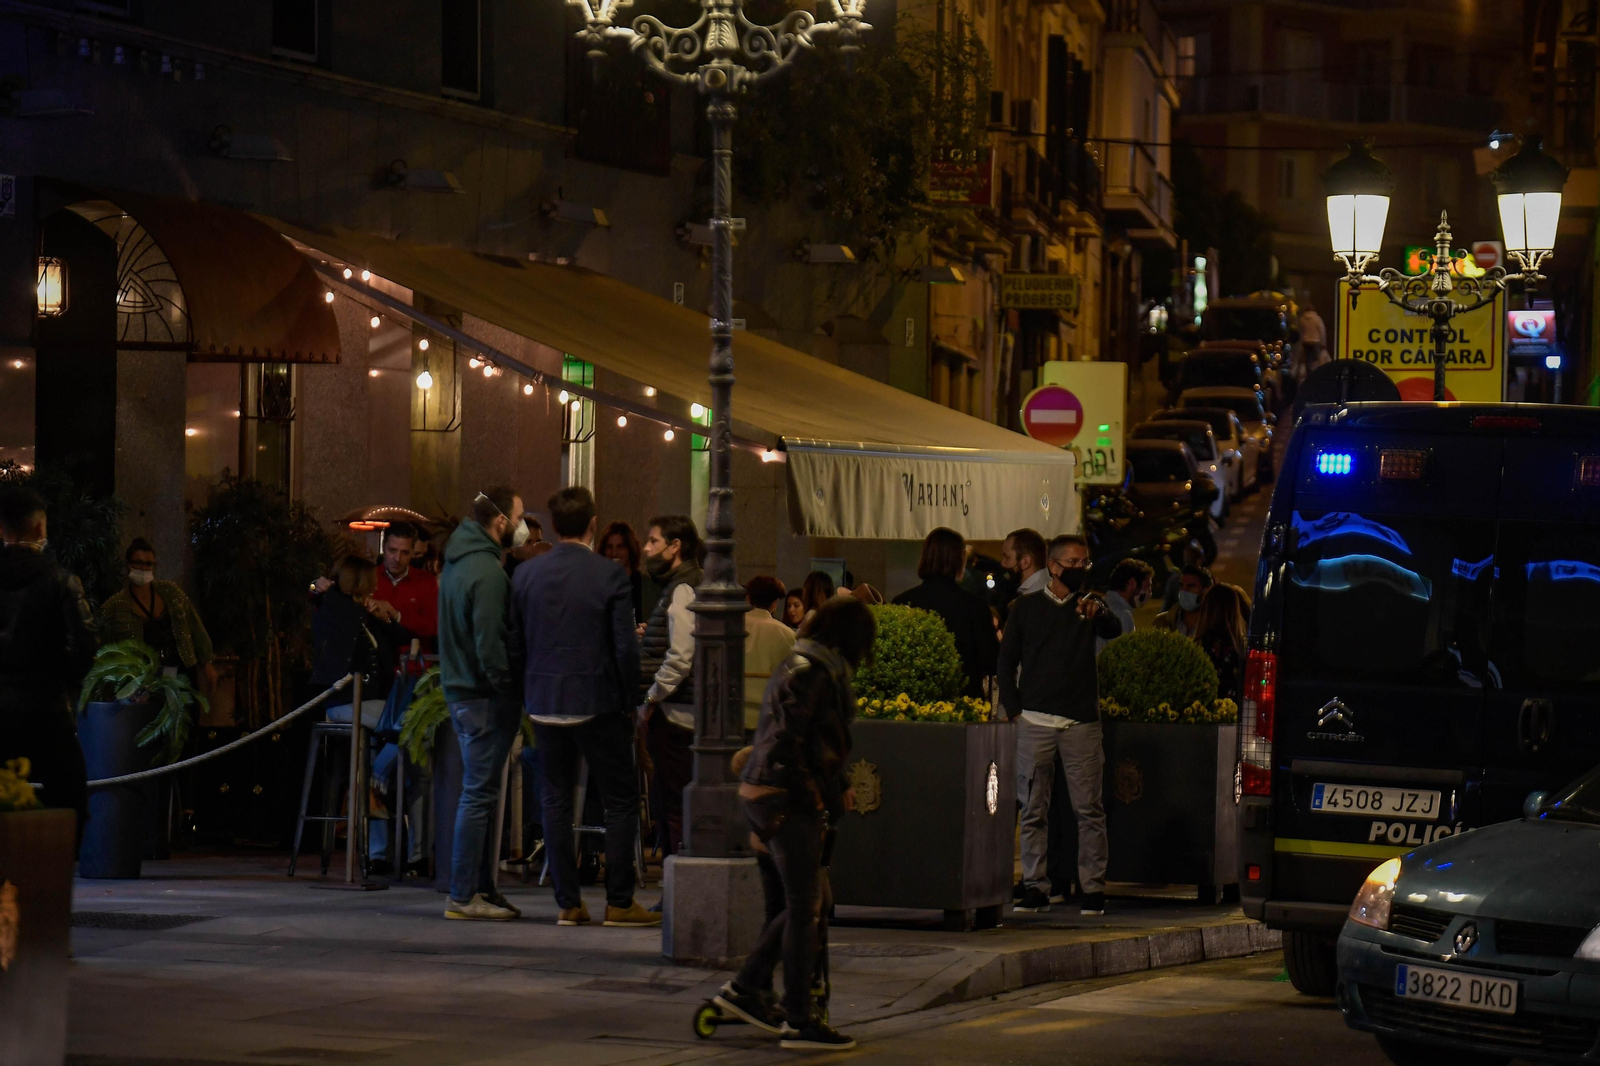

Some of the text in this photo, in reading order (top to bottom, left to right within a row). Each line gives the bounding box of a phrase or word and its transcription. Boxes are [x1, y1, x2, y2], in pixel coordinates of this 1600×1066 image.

[1005, 292, 1072, 306] PROGRESO
[1352, 349, 1393, 364] POR
[1327, 788, 1383, 811] 4508
[1392, 792, 1434, 814] JZJ
[1368, 821, 1477, 845] POLICÍ
[1408, 971, 1461, 1001] 3822
[1470, 979, 1512, 1008] DKD
